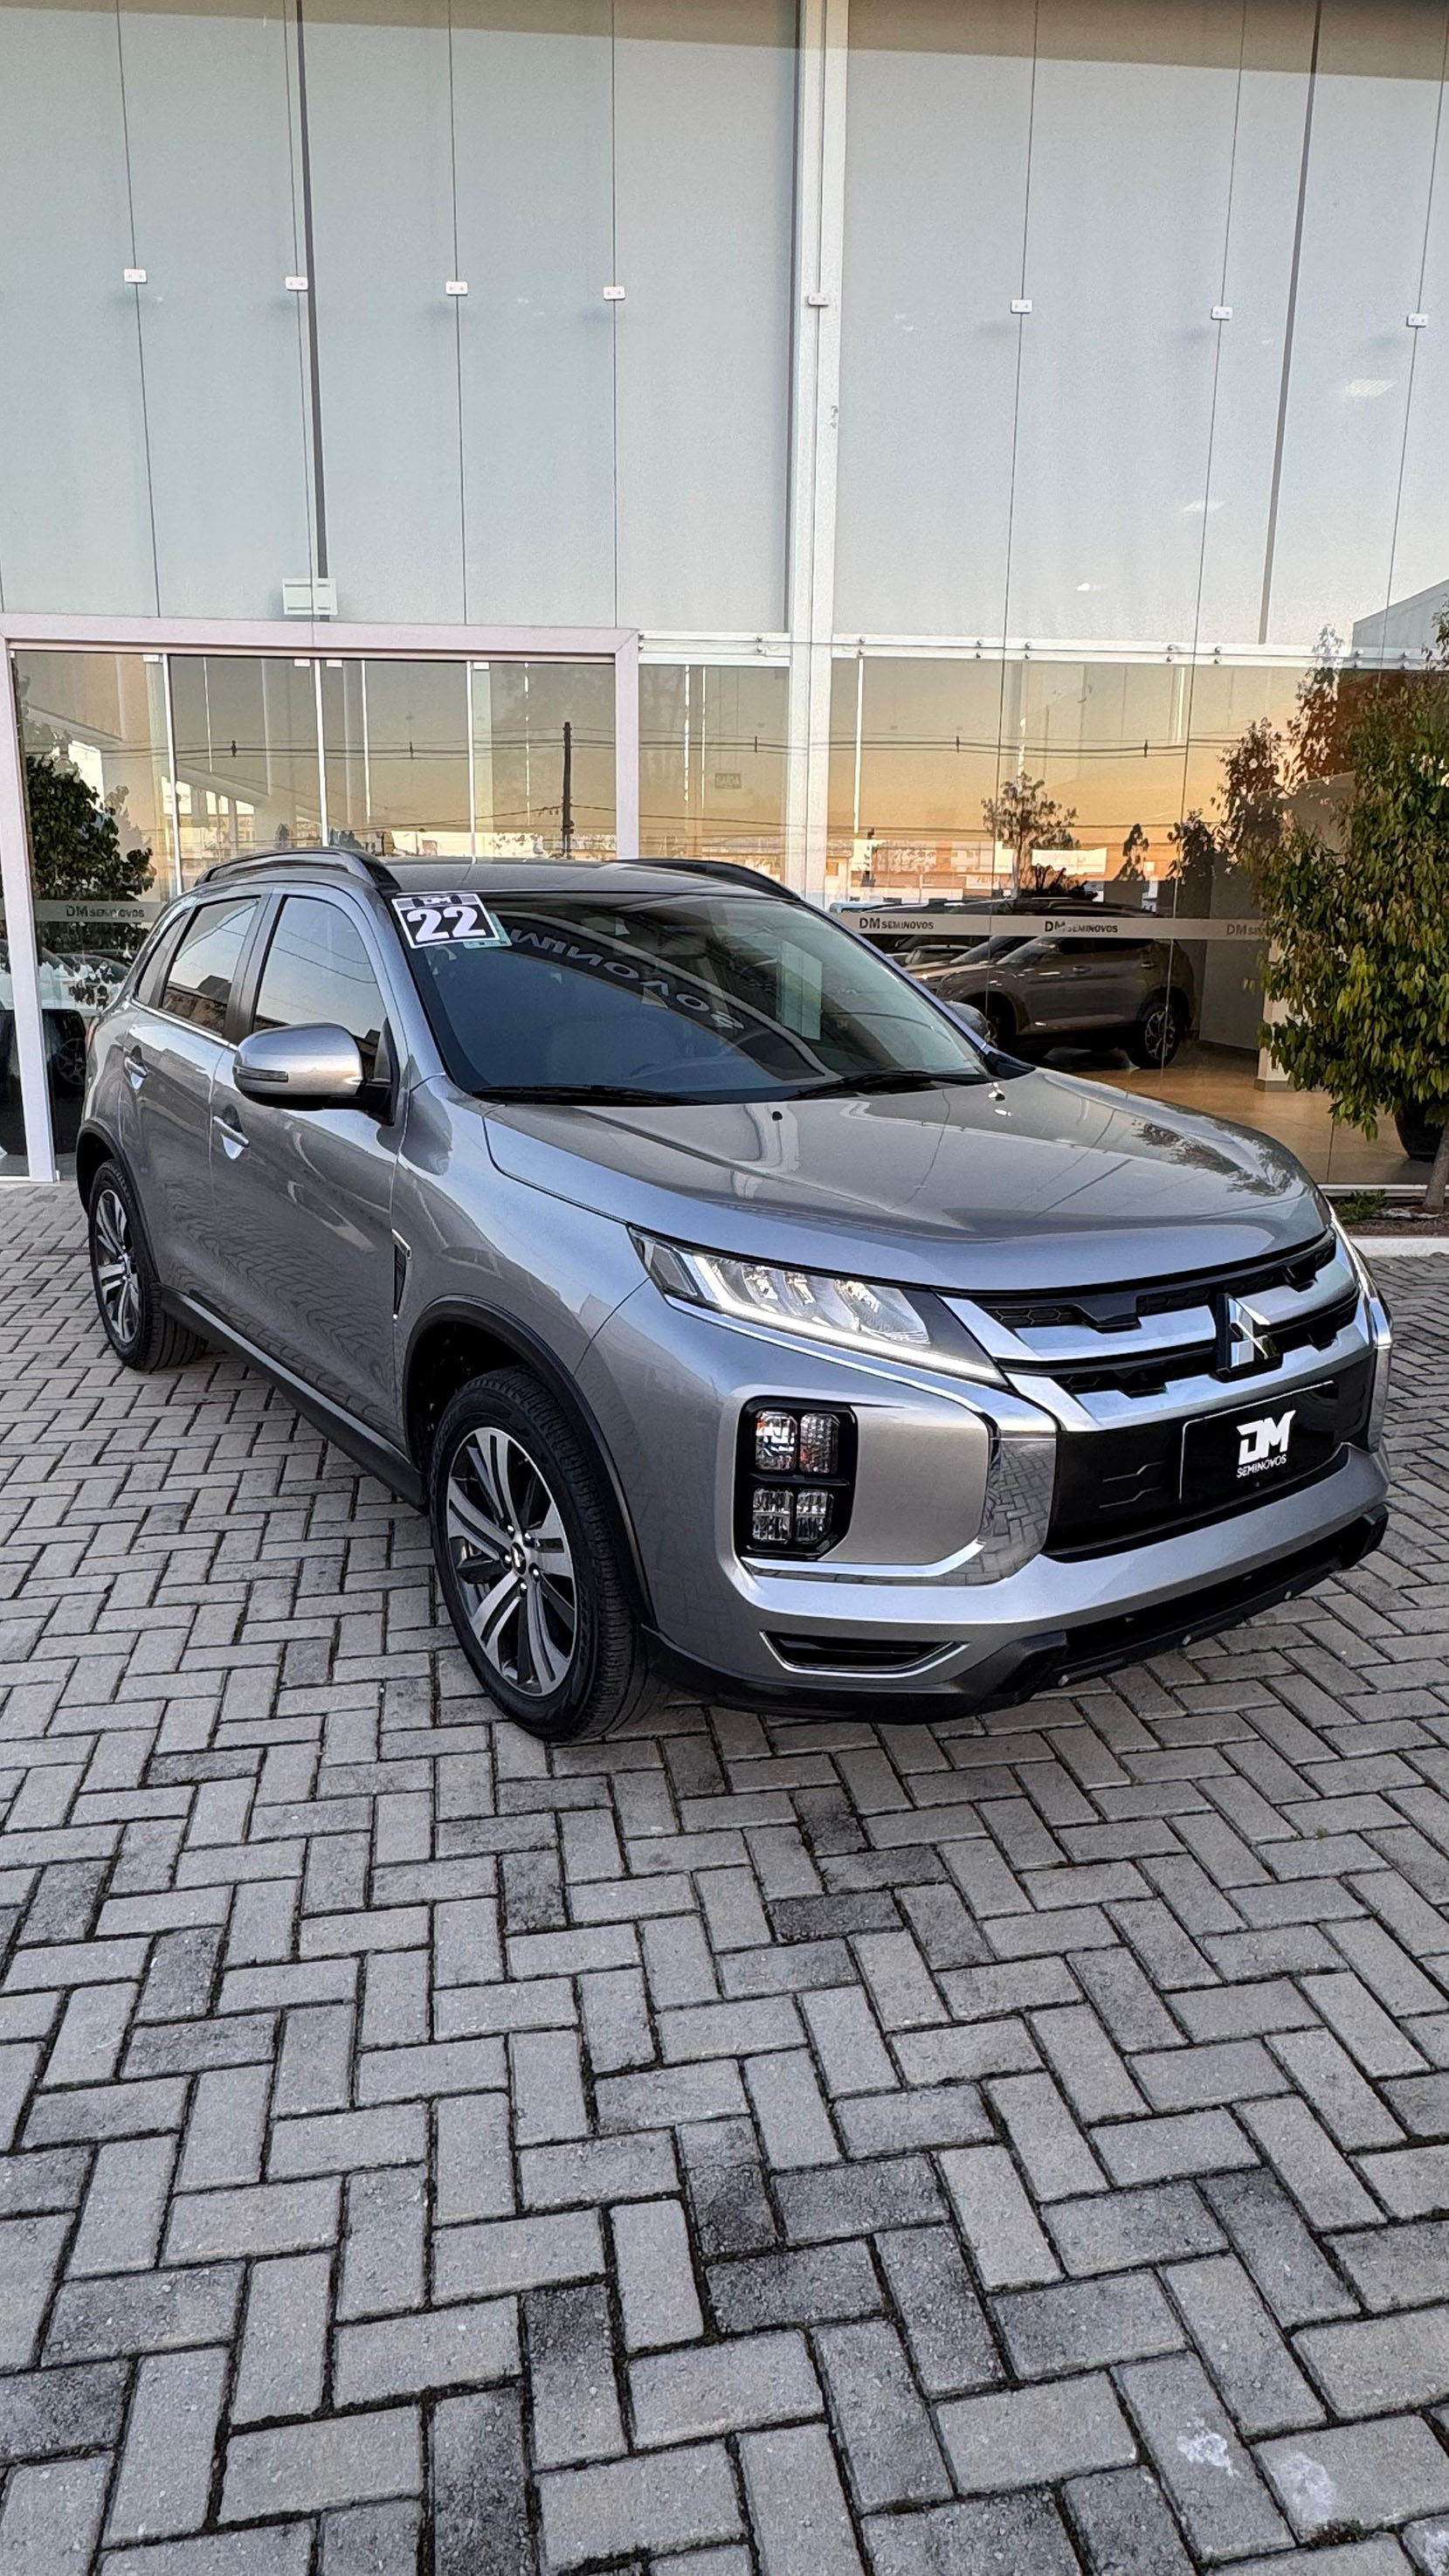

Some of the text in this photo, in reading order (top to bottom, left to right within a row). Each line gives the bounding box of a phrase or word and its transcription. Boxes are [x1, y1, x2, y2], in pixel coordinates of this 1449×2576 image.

[66, 905, 88, 917] DM
[406, 906, 486, 943] 22
[859, 917, 935, 930] DM SEMINOVOS
[1045, 921, 1066, 932] DM
[1226, 923, 1246, 936] DM
[1236, 1410, 1296, 1466] DM
[1236, 1454, 1287, 1479] SEMINOVOS
